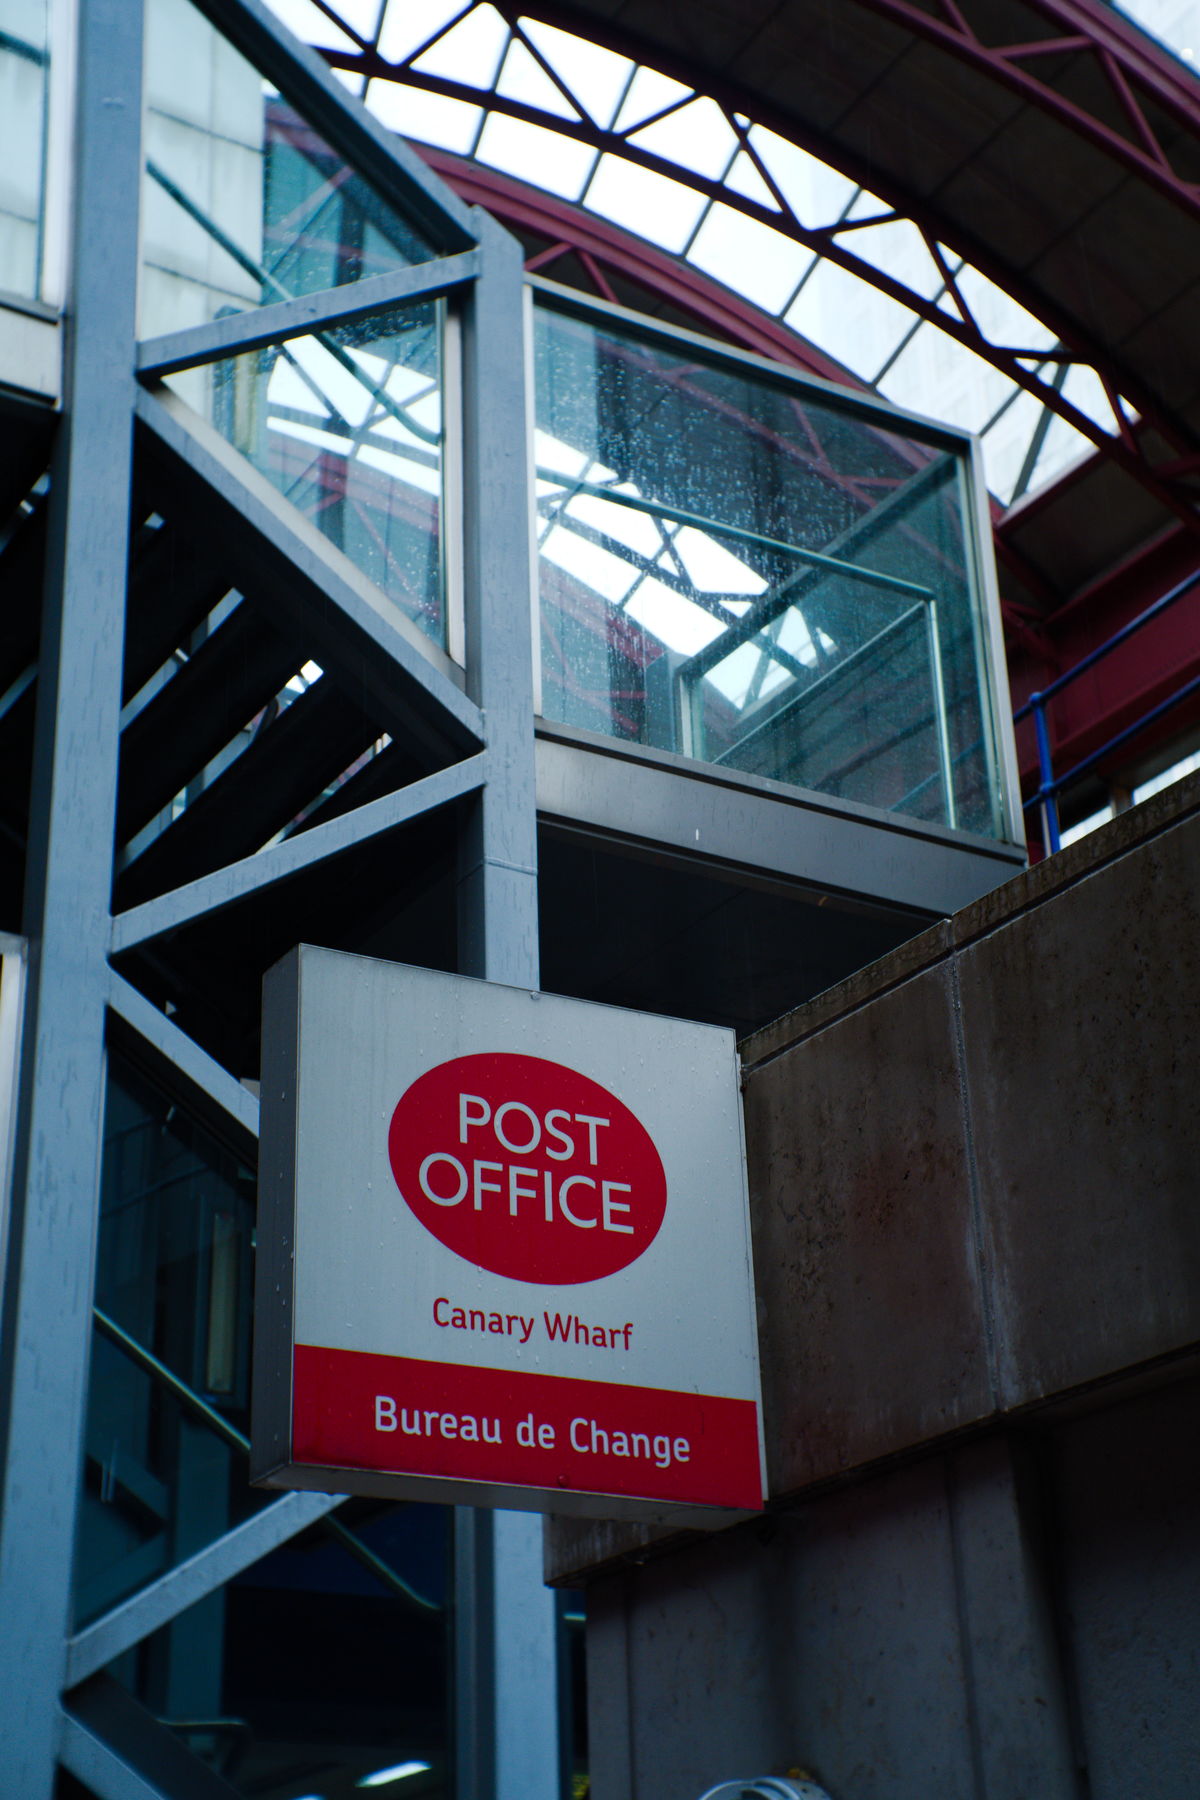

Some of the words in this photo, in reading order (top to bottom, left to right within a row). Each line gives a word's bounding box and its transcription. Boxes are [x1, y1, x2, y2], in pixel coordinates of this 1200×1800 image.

[459, 1093, 610, 1166] POST
[418, 1152, 634, 1234] OFFICE
[432, 1298, 534, 1344] Canary
[543, 1312, 633, 1351] Wharf
[374, 1395, 502, 1445] Bureau
[516, 1413, 555, 1449] de
[569, 1418, 691, 1468] Change
